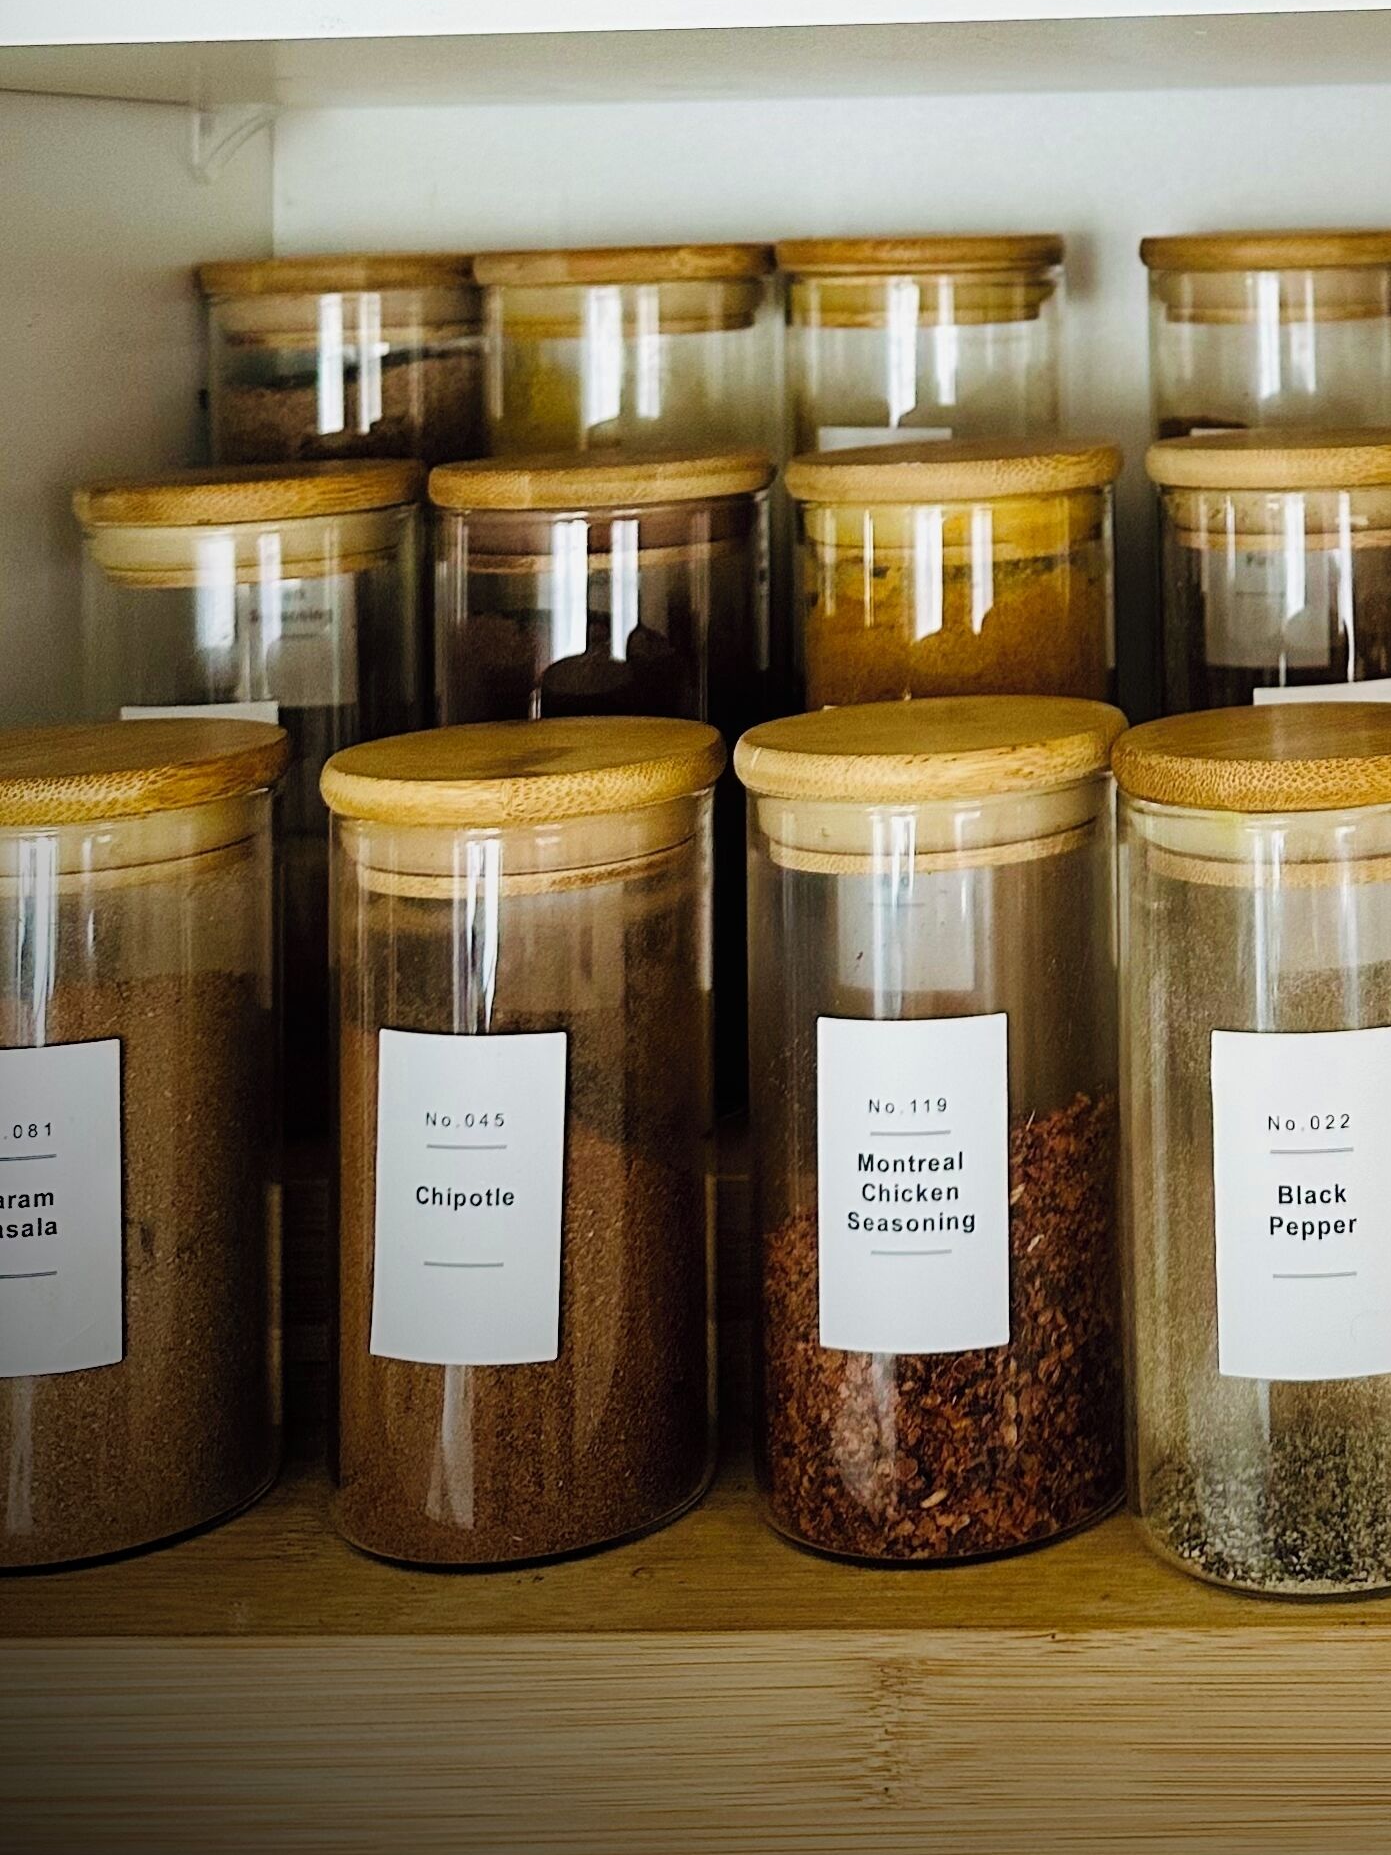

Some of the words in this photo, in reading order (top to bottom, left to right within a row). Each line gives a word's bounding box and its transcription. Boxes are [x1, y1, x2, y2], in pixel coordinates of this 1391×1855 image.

[868, 1097, 947, 1114] No.119
[426, 1112, 505, 1128] No.045
[1268, 1113, 1350, 1131] No.022
[2, 1122, 53, 1140] .081
[858, 1150, 963, 1173] Montreal
[0, 1191, 54, 1210] ram
[415, 1185, 515, 1212] Chipotle
[861, 1183, 959, 1203] Chicken
[1278, 1183, 1347, 1205] Black
[0, 1217, 58, 1239] sala
[847, 1211, 975, 1234] Seasoning
[1269, 1215, 1358, 1241] Pepper
